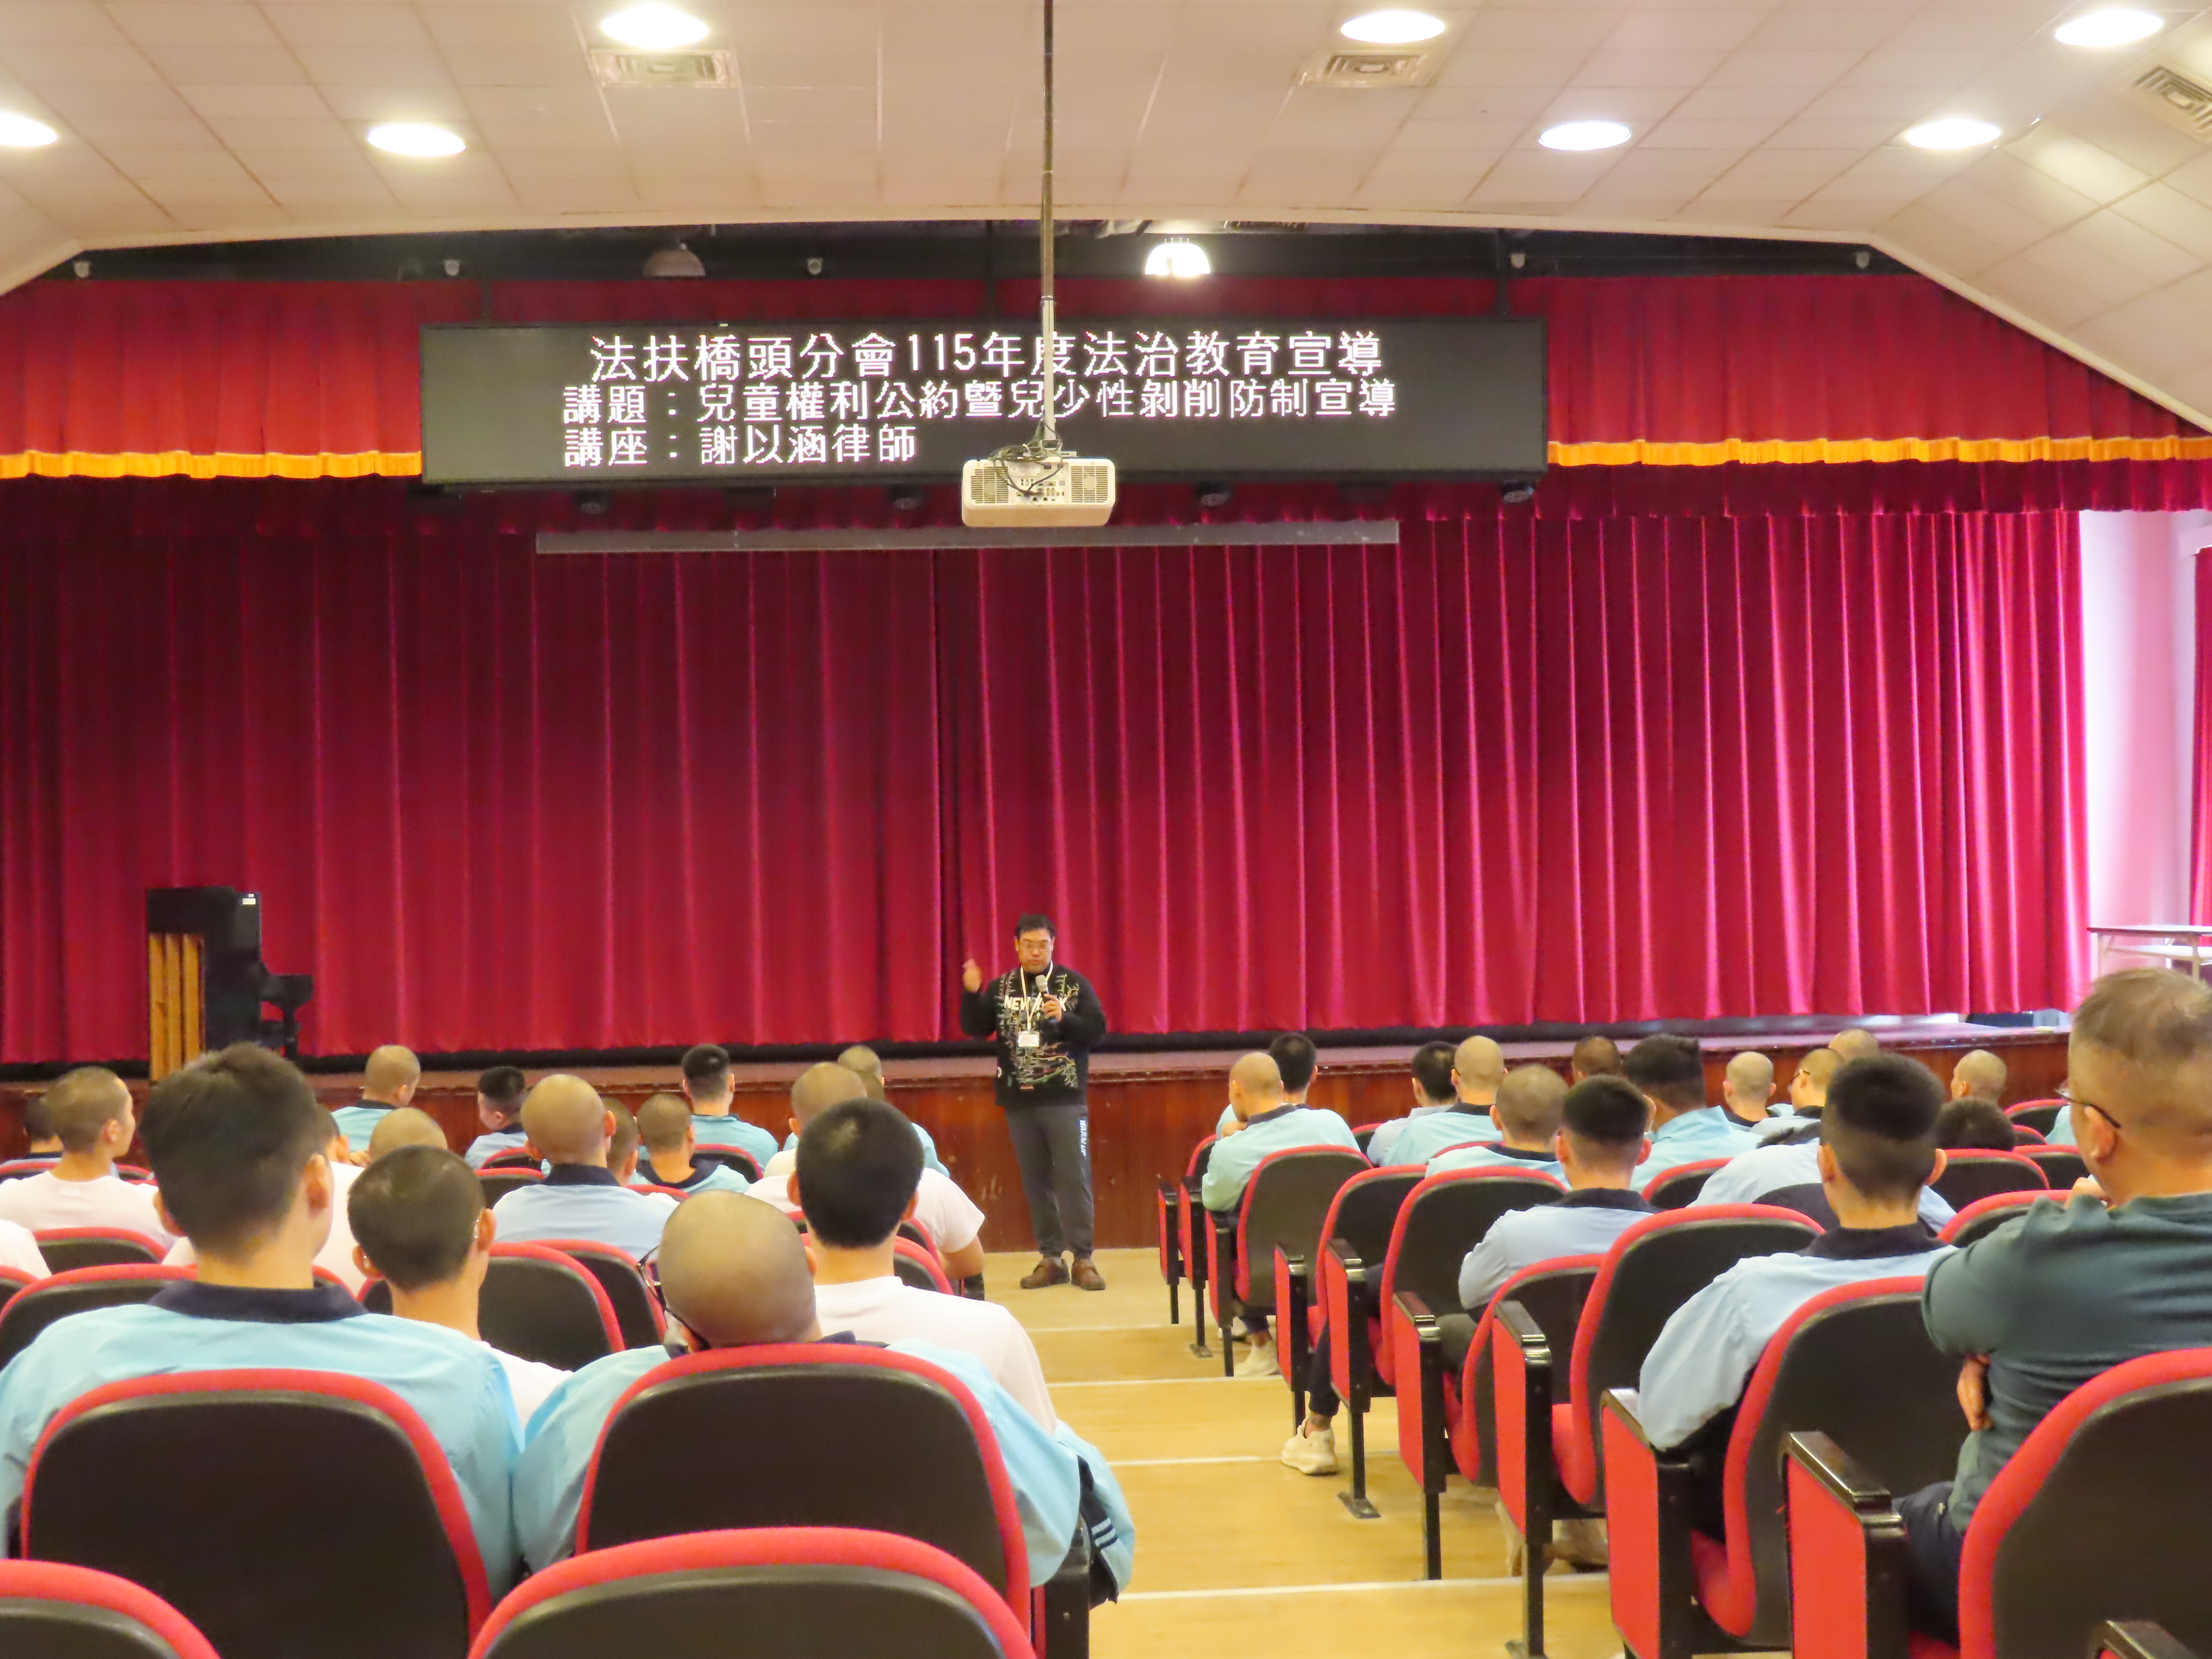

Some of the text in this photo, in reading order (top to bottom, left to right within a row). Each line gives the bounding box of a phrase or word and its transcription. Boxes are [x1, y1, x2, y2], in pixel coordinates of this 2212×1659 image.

[590, 330, 1382, 382] 法扶橋頭分會115年度法治教育宣導
